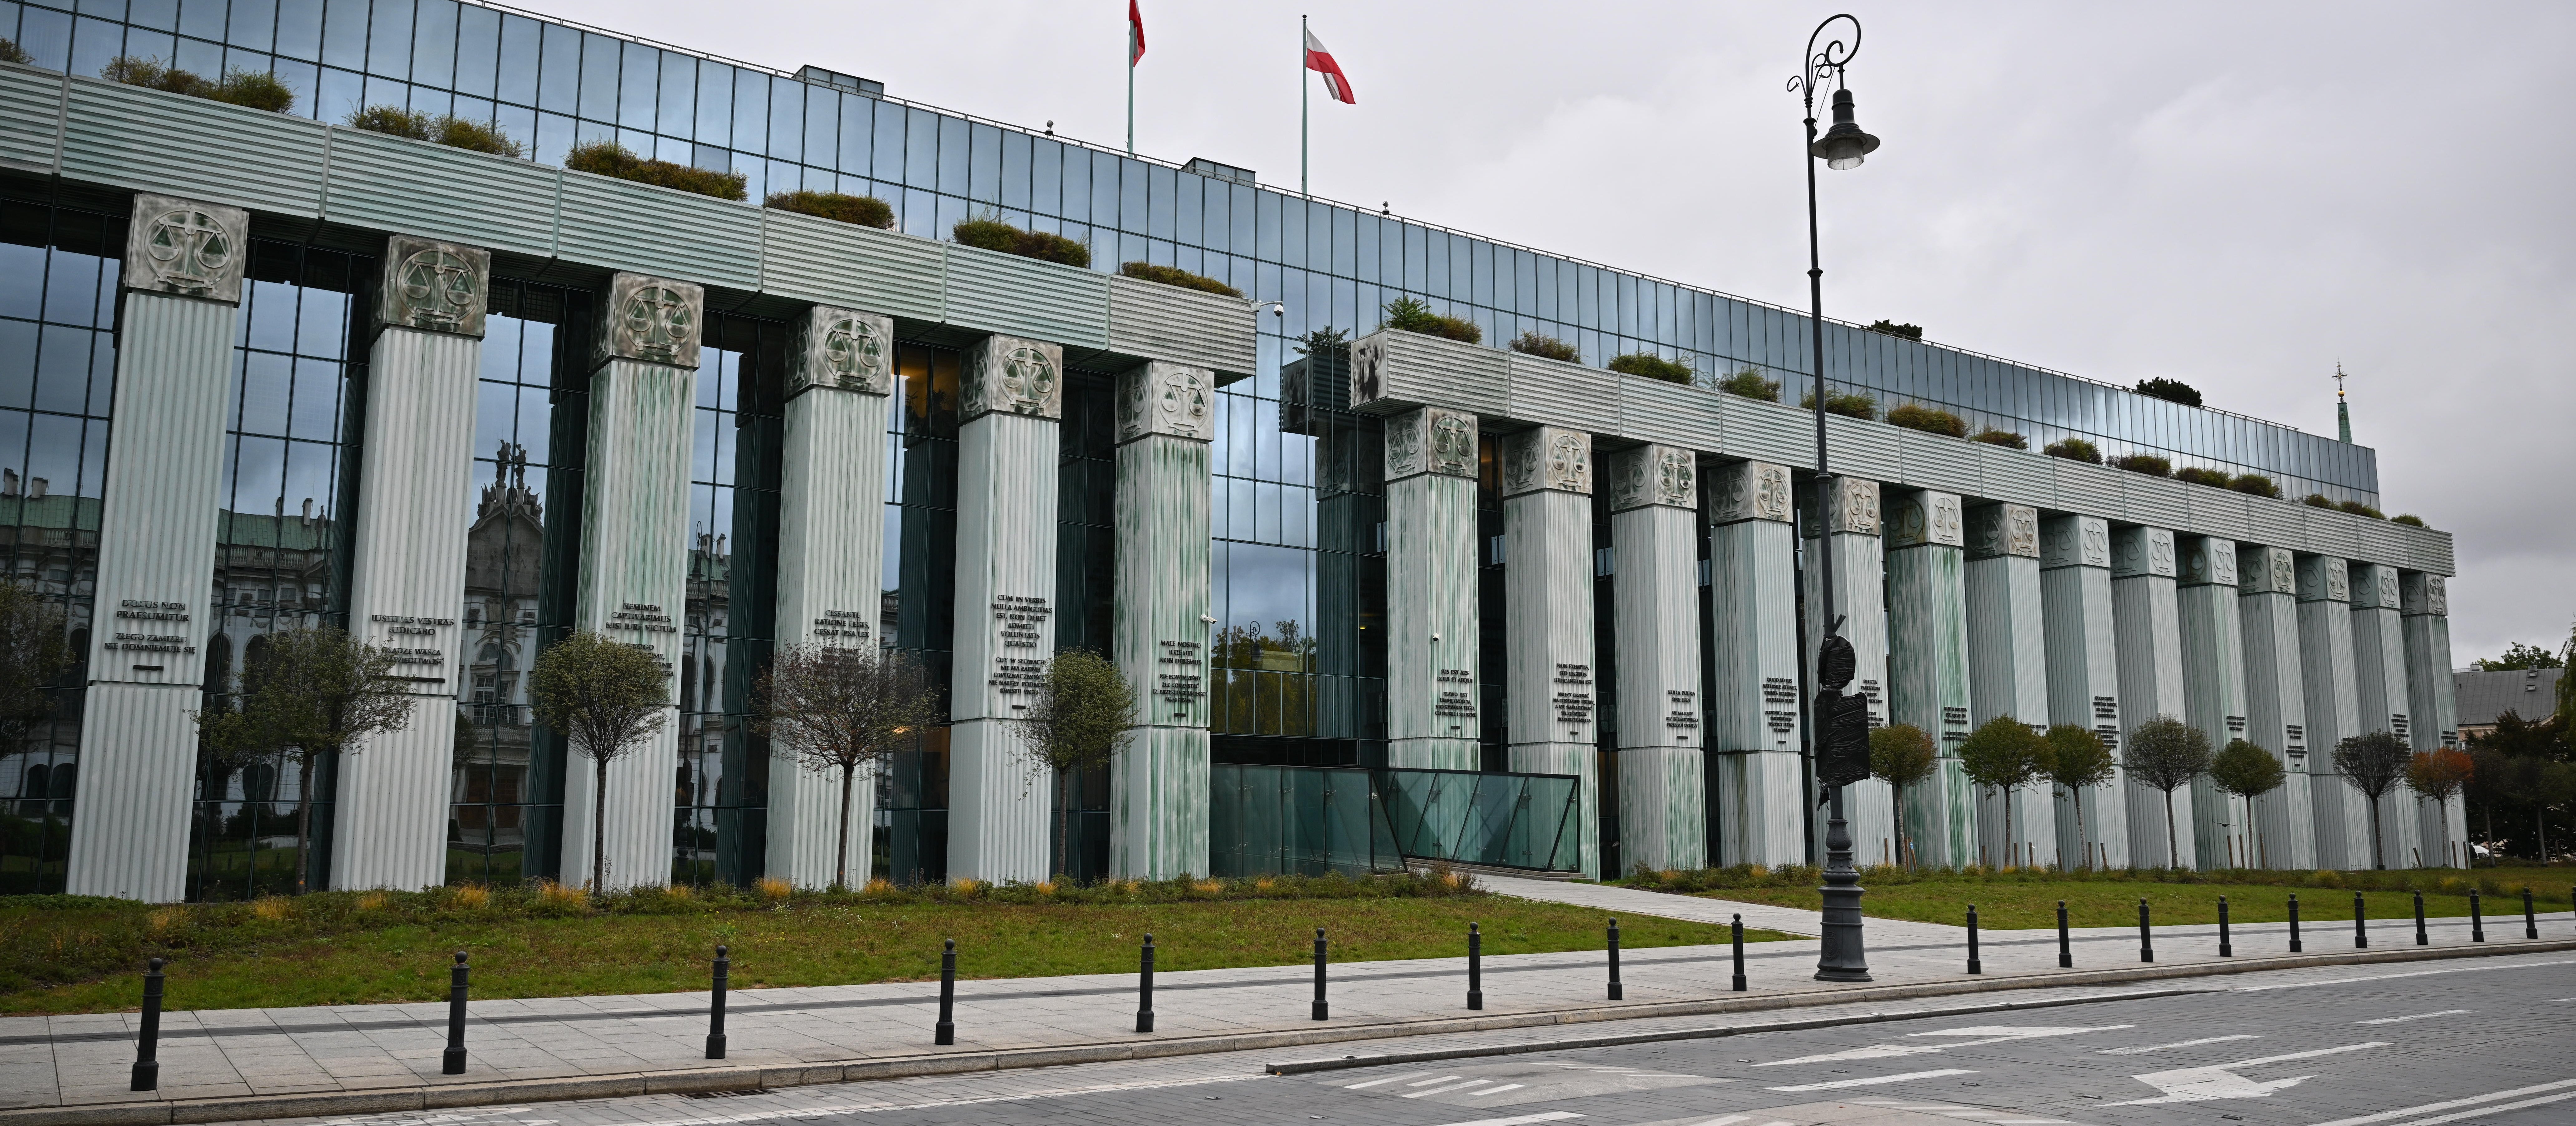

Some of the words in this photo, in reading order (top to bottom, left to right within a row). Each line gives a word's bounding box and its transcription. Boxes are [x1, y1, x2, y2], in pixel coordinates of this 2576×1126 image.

[122, 600, 158, 608] DOLUS
[162, 602, 186, 610] NON
[623, 603, 661, 612] NEMINEM
[117, 611, 189, 621] PRAESUMITUR
[372, 615, 414, 623] IUSTITIAS
[417, 617, 454, 626] VESTRAS
[612, 612, 671, 622] CAPTIVABIMUS
[849, 621, 870, 629] LEGIS,
[389, 626, 436, 635] IUDICABO
[122, 644, 181, 653] DOMNIEMUJE
